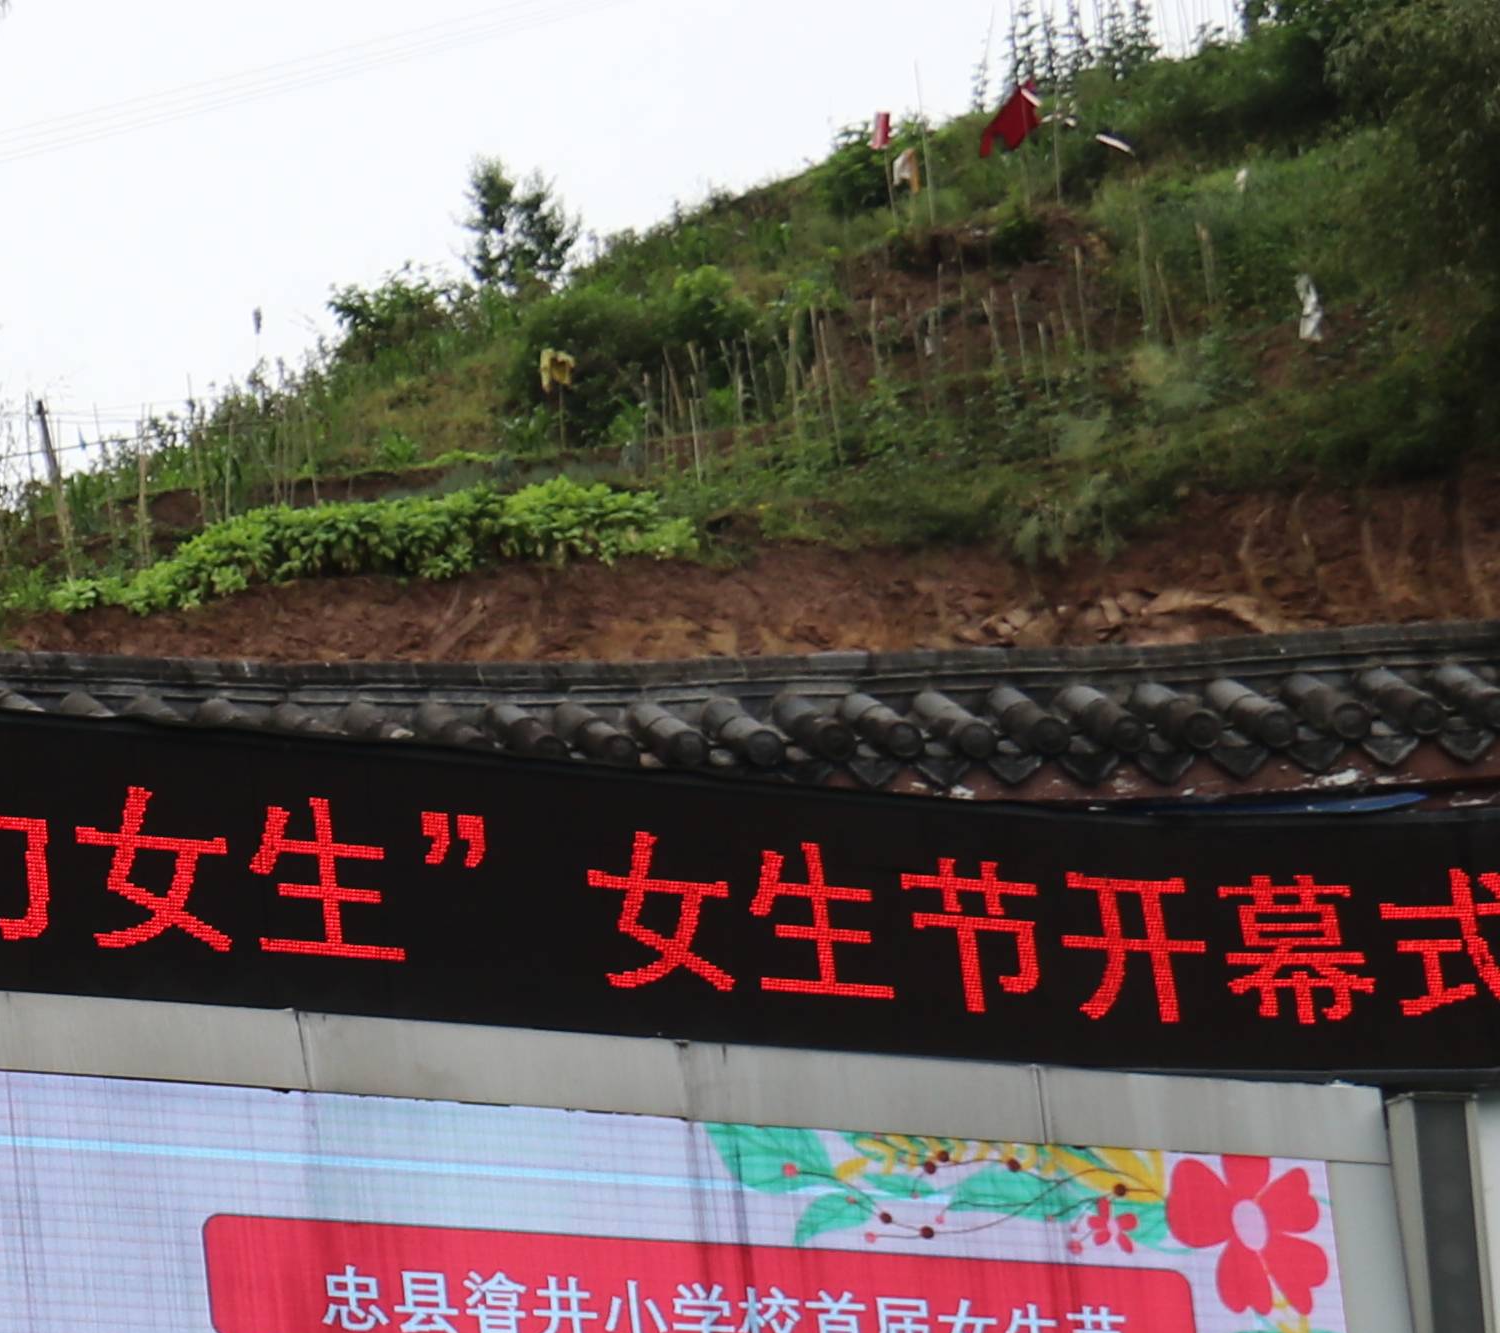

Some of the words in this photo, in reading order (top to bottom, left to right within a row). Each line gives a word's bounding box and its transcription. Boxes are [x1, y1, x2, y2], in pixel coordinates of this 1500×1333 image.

[586, 830, 1500, 1025] 女生节开幕式
